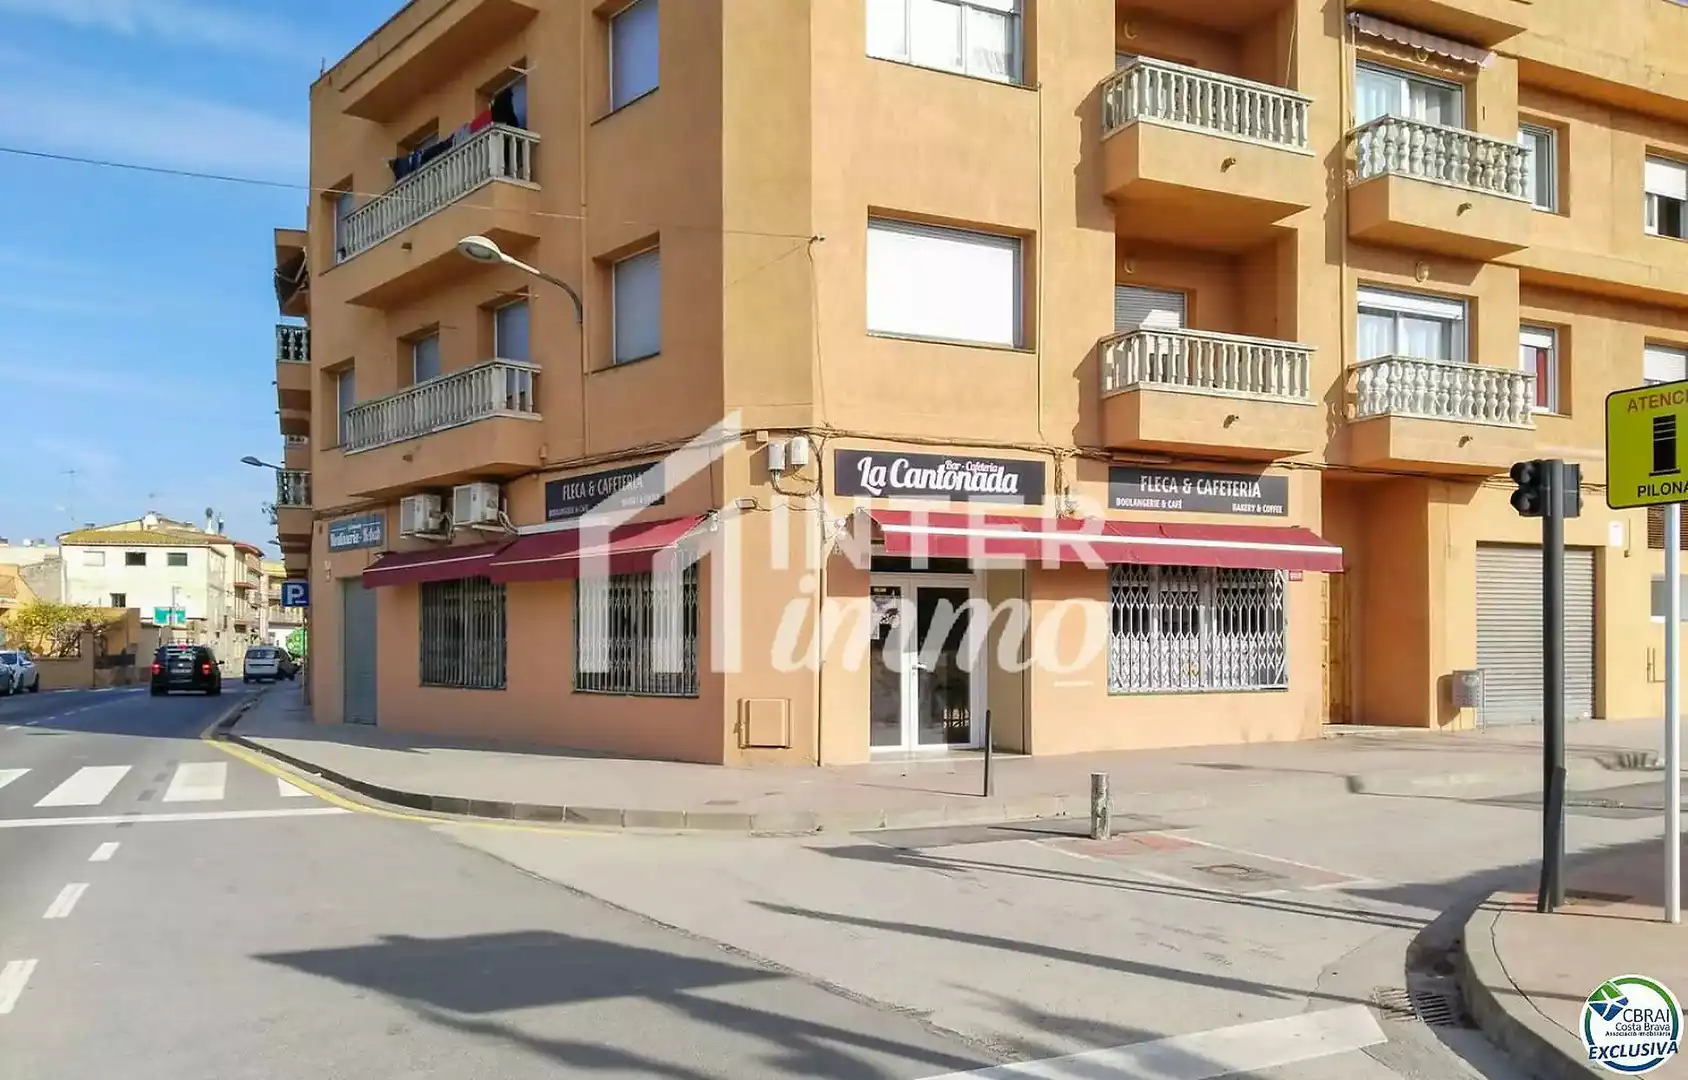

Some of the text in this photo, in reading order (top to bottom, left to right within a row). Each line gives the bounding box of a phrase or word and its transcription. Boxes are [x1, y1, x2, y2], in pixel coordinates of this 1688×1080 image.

[1627, 389, 1688, 412] ATENCI
[562, 472, 644, 500] FLECA & CAFETERIA
[857, 456, 1018, 495] La Cantonada
[1140, 475, 1262, 498] FLECA & CAFETERIA
[287, 584, 304, 604] P
